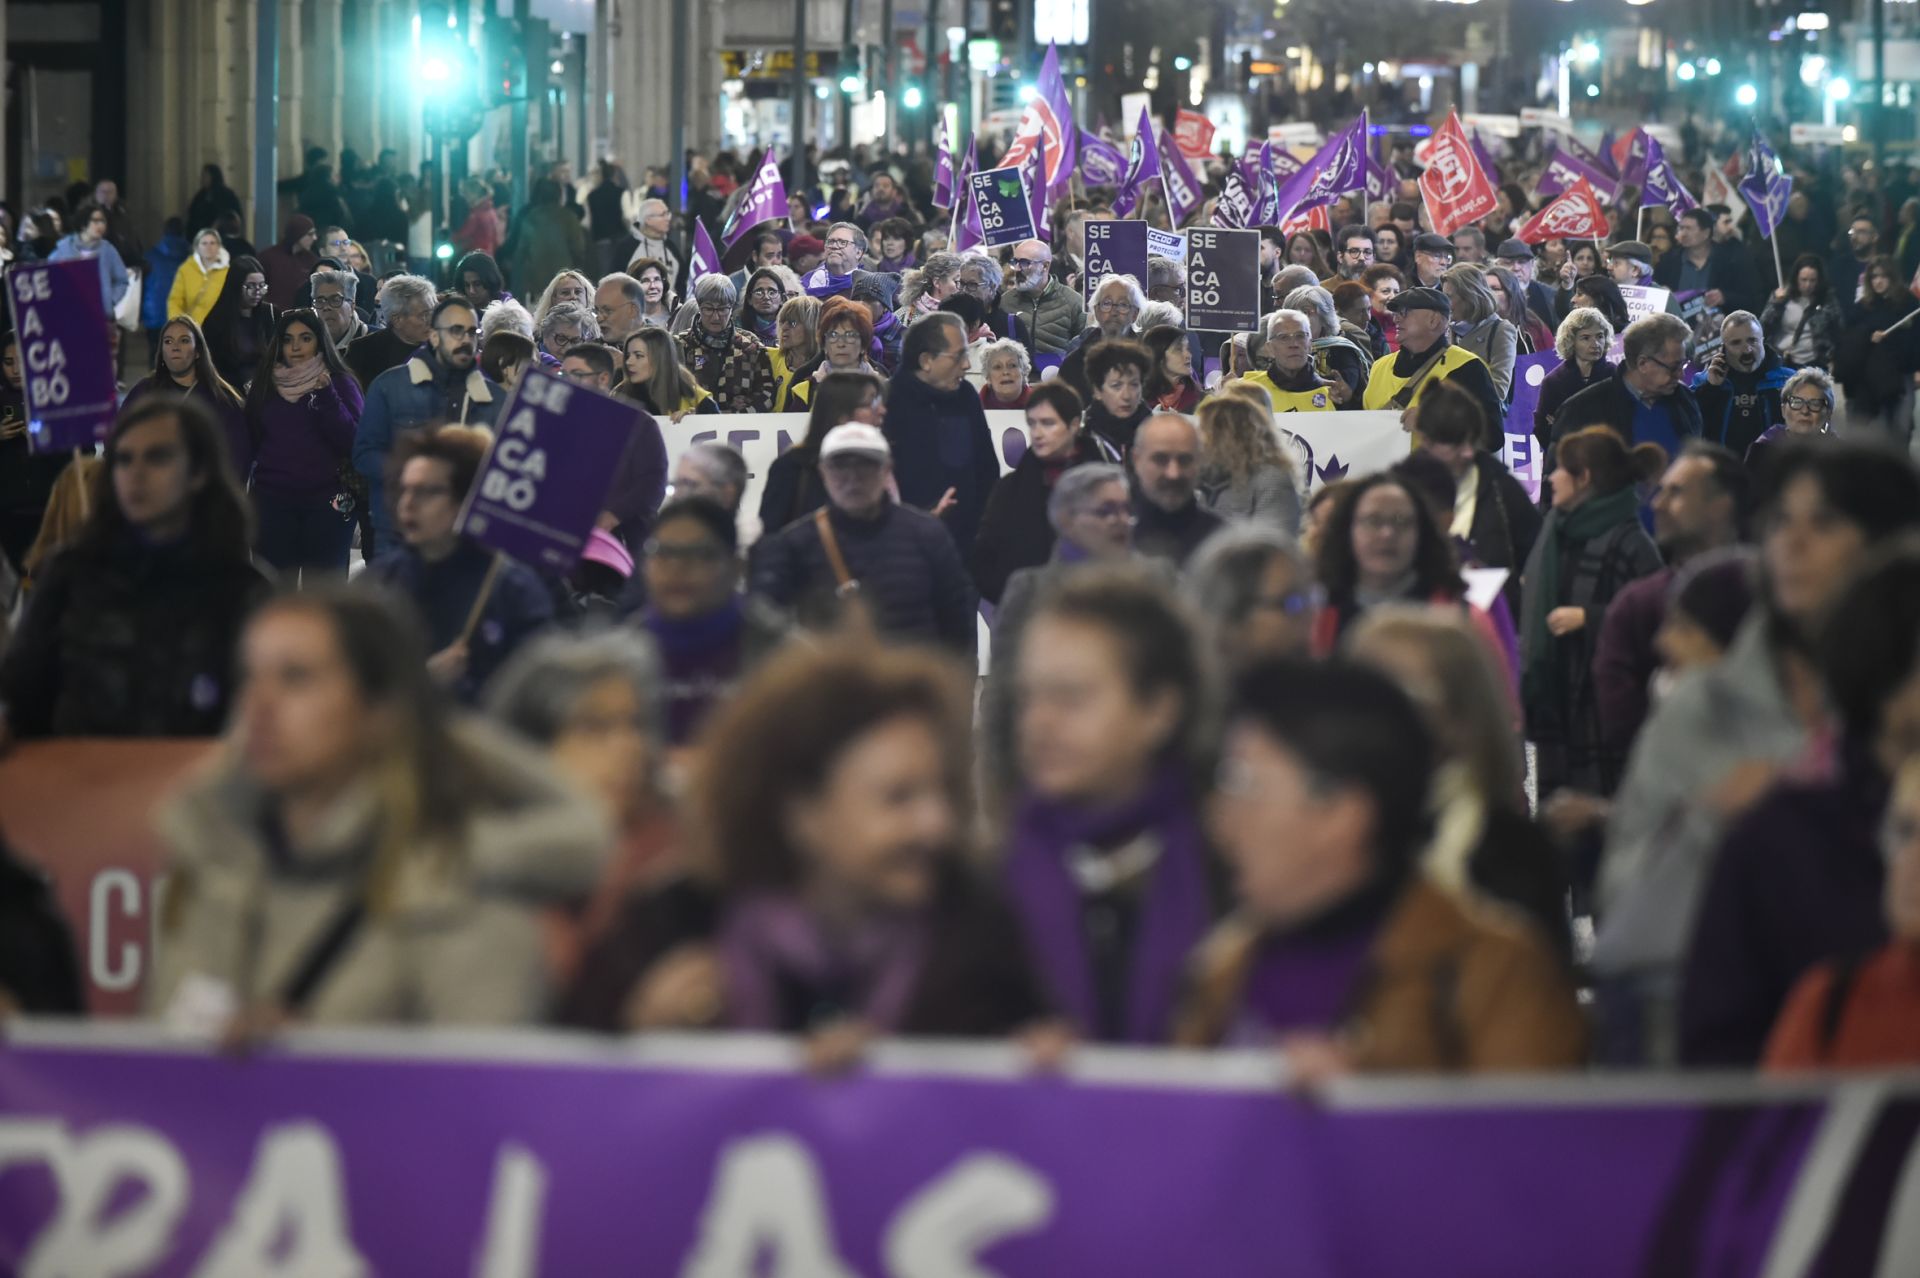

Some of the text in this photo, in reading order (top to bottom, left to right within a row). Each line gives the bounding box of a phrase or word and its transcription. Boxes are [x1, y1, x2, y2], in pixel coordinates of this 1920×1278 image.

[973, 175, 992, 189] SE
[978, 190, 988, 202] A
[980, 202, 1002, 216] CA
[983, 212, 1004, 230] BÓ
[1088, 224, 1111, 239] SE
[1088, 242, 1101, 256] A
[1190, 233, 1217, 249] SE
[1088, 259, 1114, 273] CA
[1190, 251, 1206, 267] A
[14, 269, 52, 303] SE
[1190, 271, 1221, 287] CA
[1190, 285, 1220, 306] BÓ
[23, 305, 43, 338] A
[27, 337, 67, 373] CA
[31, 367, 70, 408] BÓ
[521, 373, 574, 415] SE
[506, 407, 536, 442] A
[495, 438, 547, 482] CA
